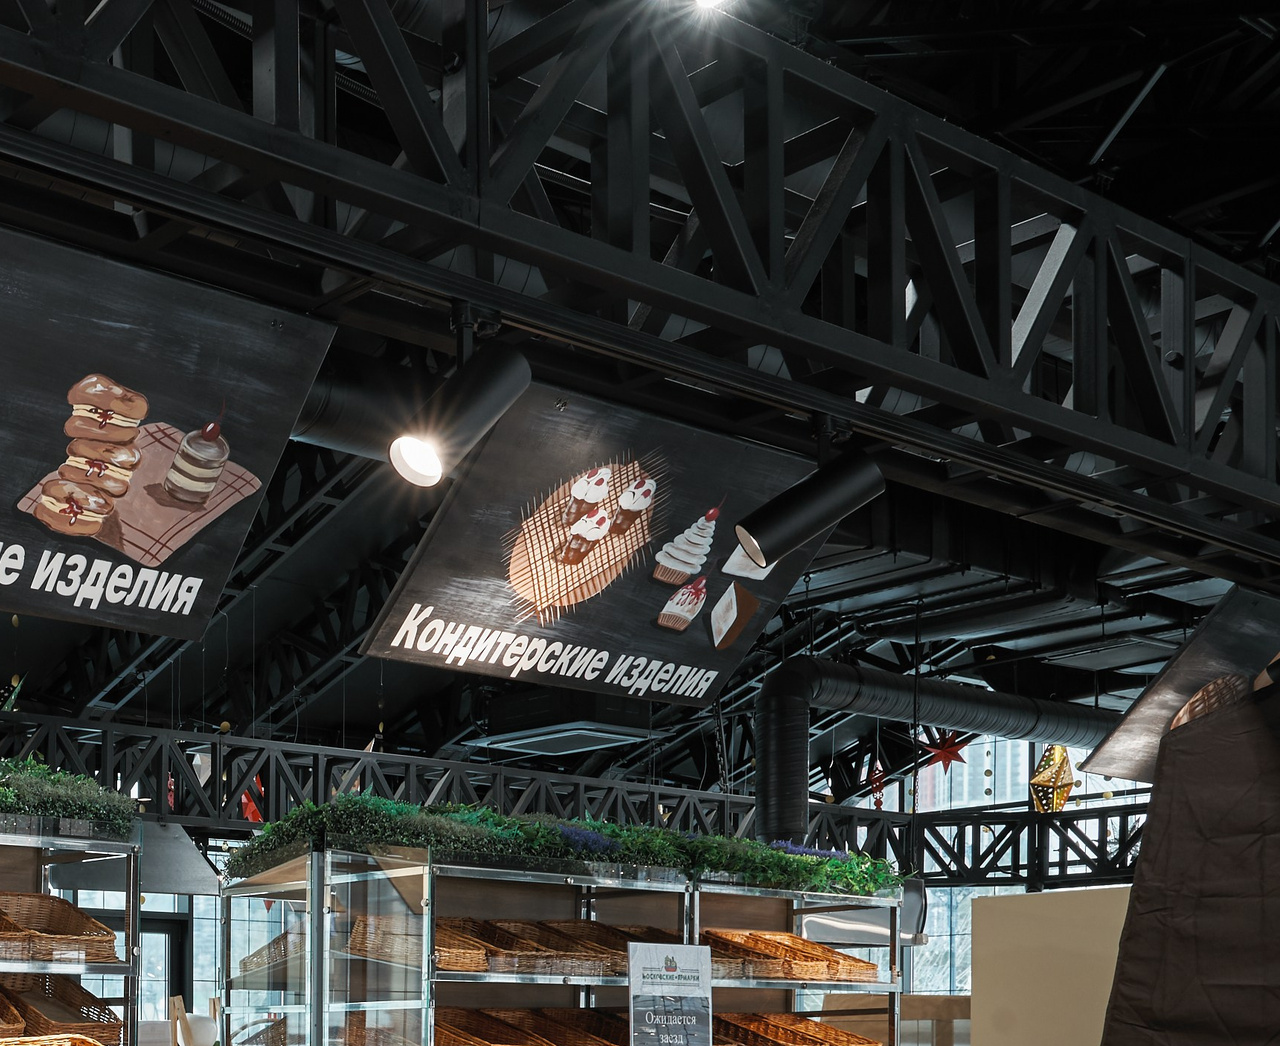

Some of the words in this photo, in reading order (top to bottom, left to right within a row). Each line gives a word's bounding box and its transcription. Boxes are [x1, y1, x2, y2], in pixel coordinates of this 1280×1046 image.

[30, 550, 204, 615] изделия
[390, 602, 609, 680] Кондитерские
[605, 652, 719, 698] изделия
[645, 1011, 696, 1025] Ожидается
[659, 1033, 683, 1044] заезд
